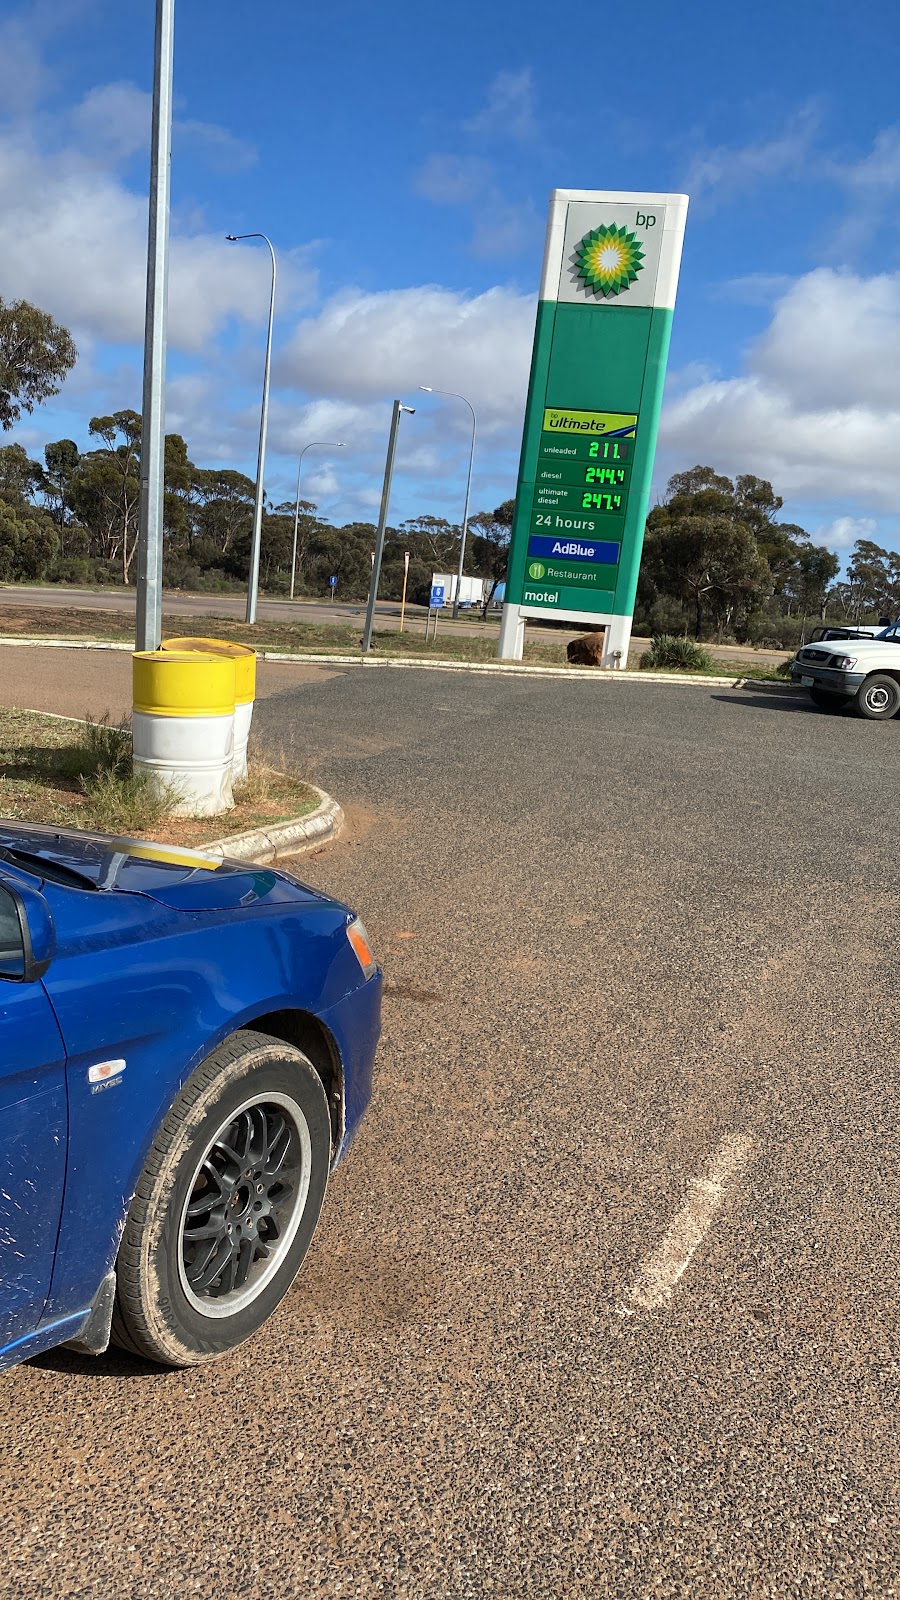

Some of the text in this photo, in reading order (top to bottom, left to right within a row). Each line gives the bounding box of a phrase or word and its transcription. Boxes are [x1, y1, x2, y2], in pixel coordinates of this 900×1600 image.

[635, 211, 656, 230] bp
[549, 417, 606, 432] ultimate
[544, 447, 577, 455] unleaded
[541, 471, 562, 480] diesel
[585, 467, 625, 485] 244.4
[538, 488, 568, 497] ultimate
[537, 497, 559, 505] diesel
[582, 492, 621, 510] 247.4
[535, 514, 595, 531] 24 hours
[552, 542, 595, 557] AdBlue
[547, 567, 597, 581] Restaurant
[524, 591, 559, 603] motel
